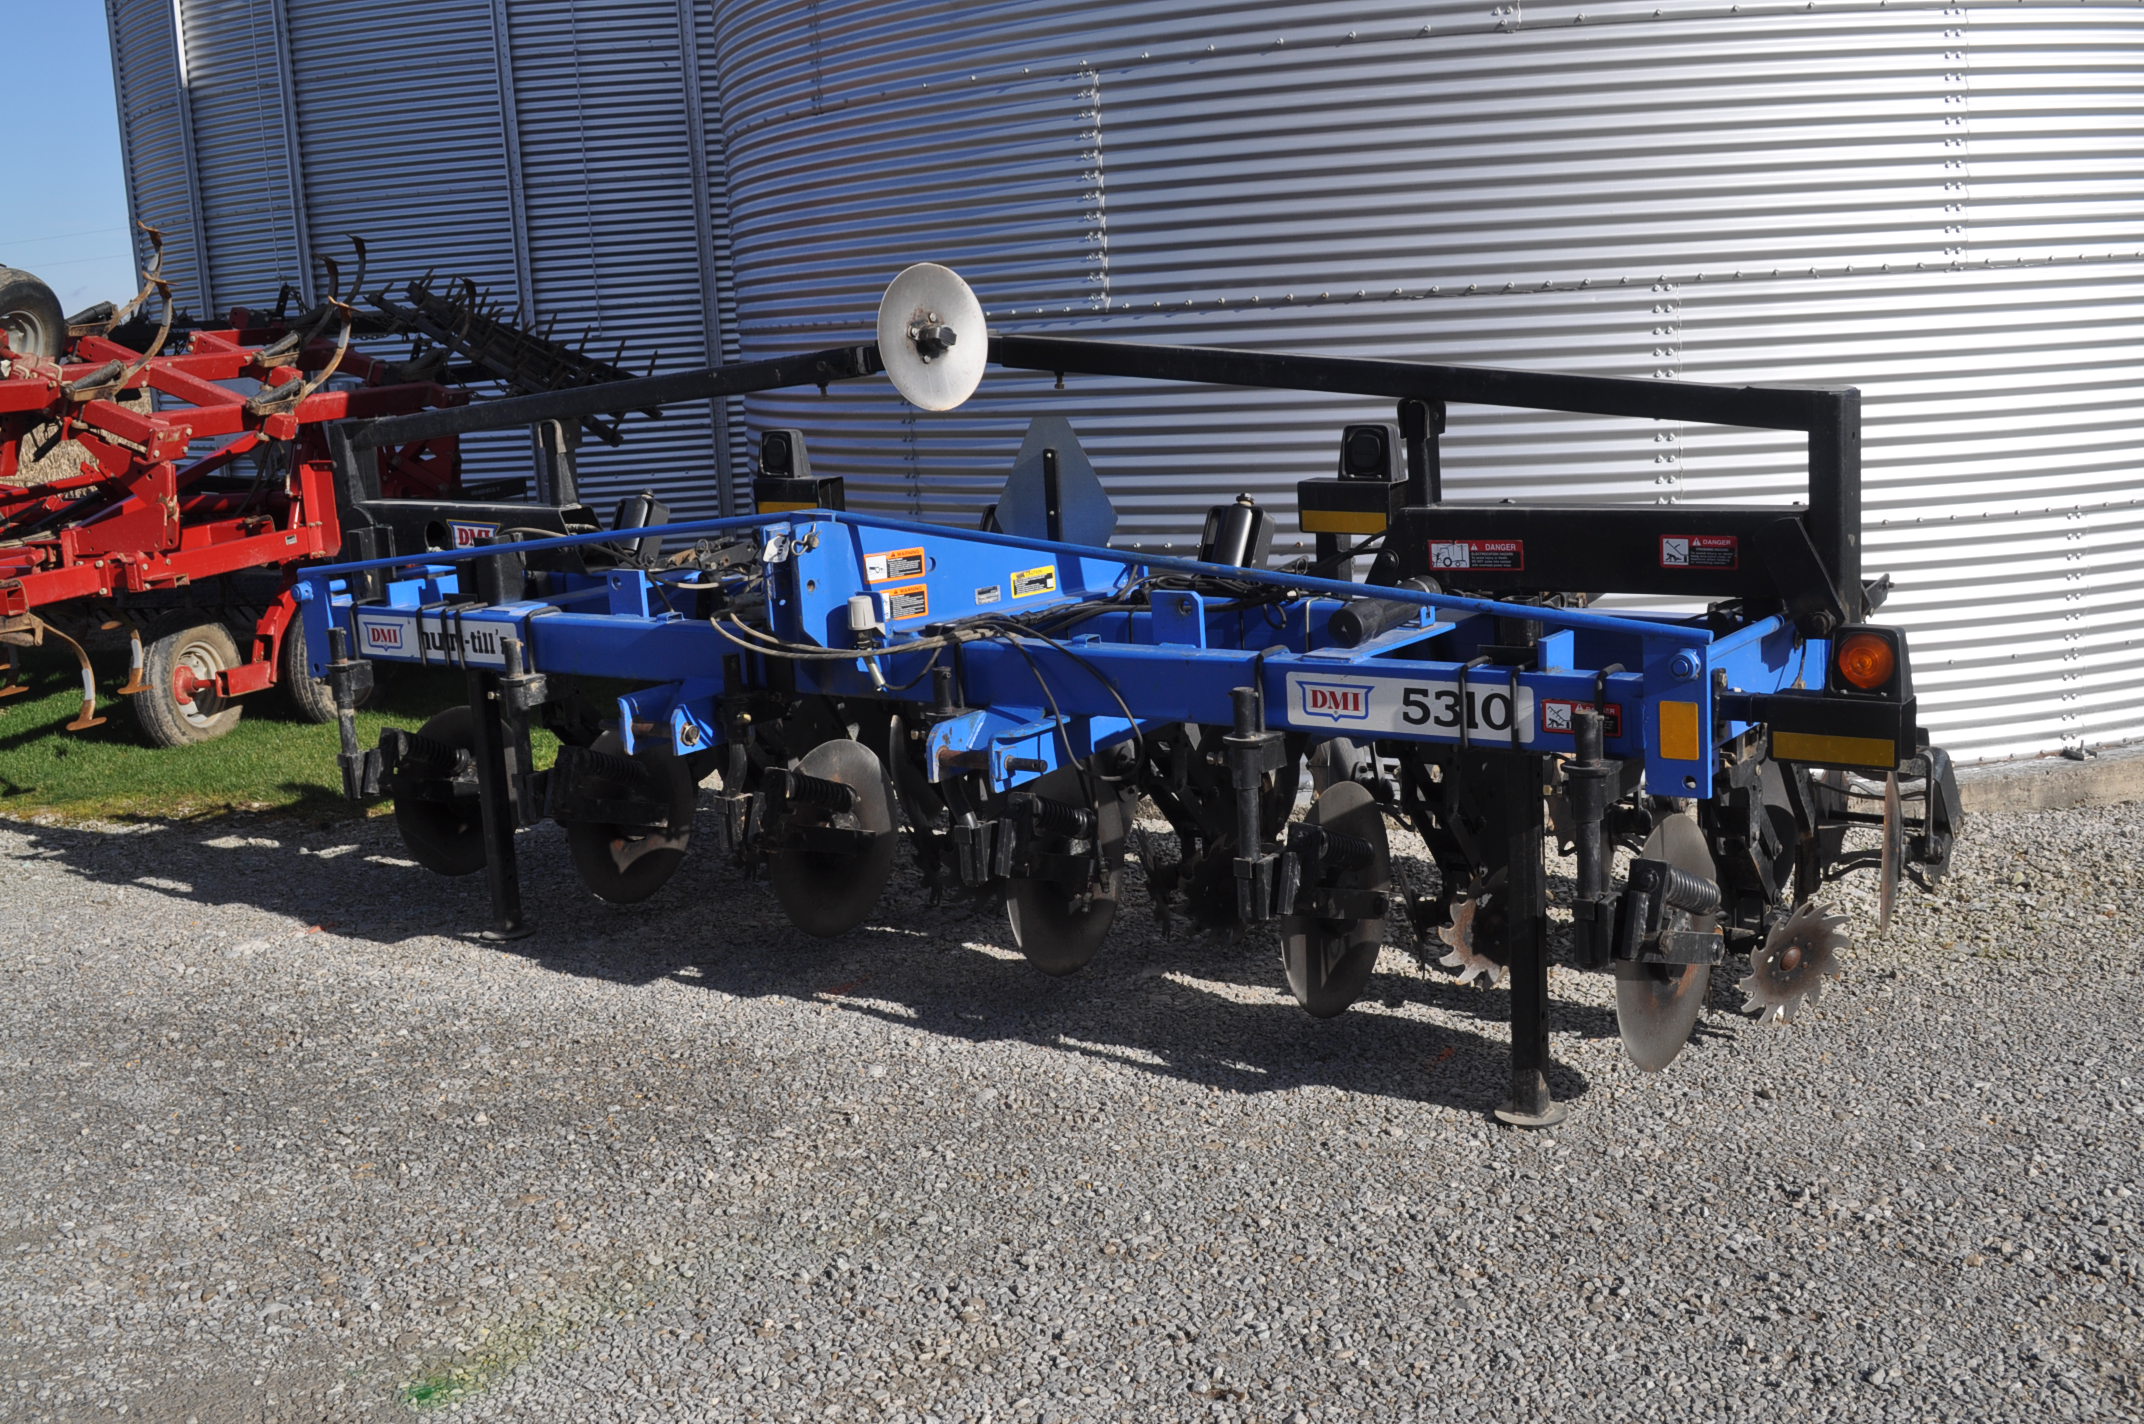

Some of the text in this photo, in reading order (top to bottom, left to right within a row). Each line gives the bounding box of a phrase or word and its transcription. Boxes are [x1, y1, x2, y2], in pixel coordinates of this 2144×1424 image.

[1484, 543, 1516, 551] DANGER
[371, 627, 398, 644] DMI
[1310, 687, 1513, 731] DMI 5310
